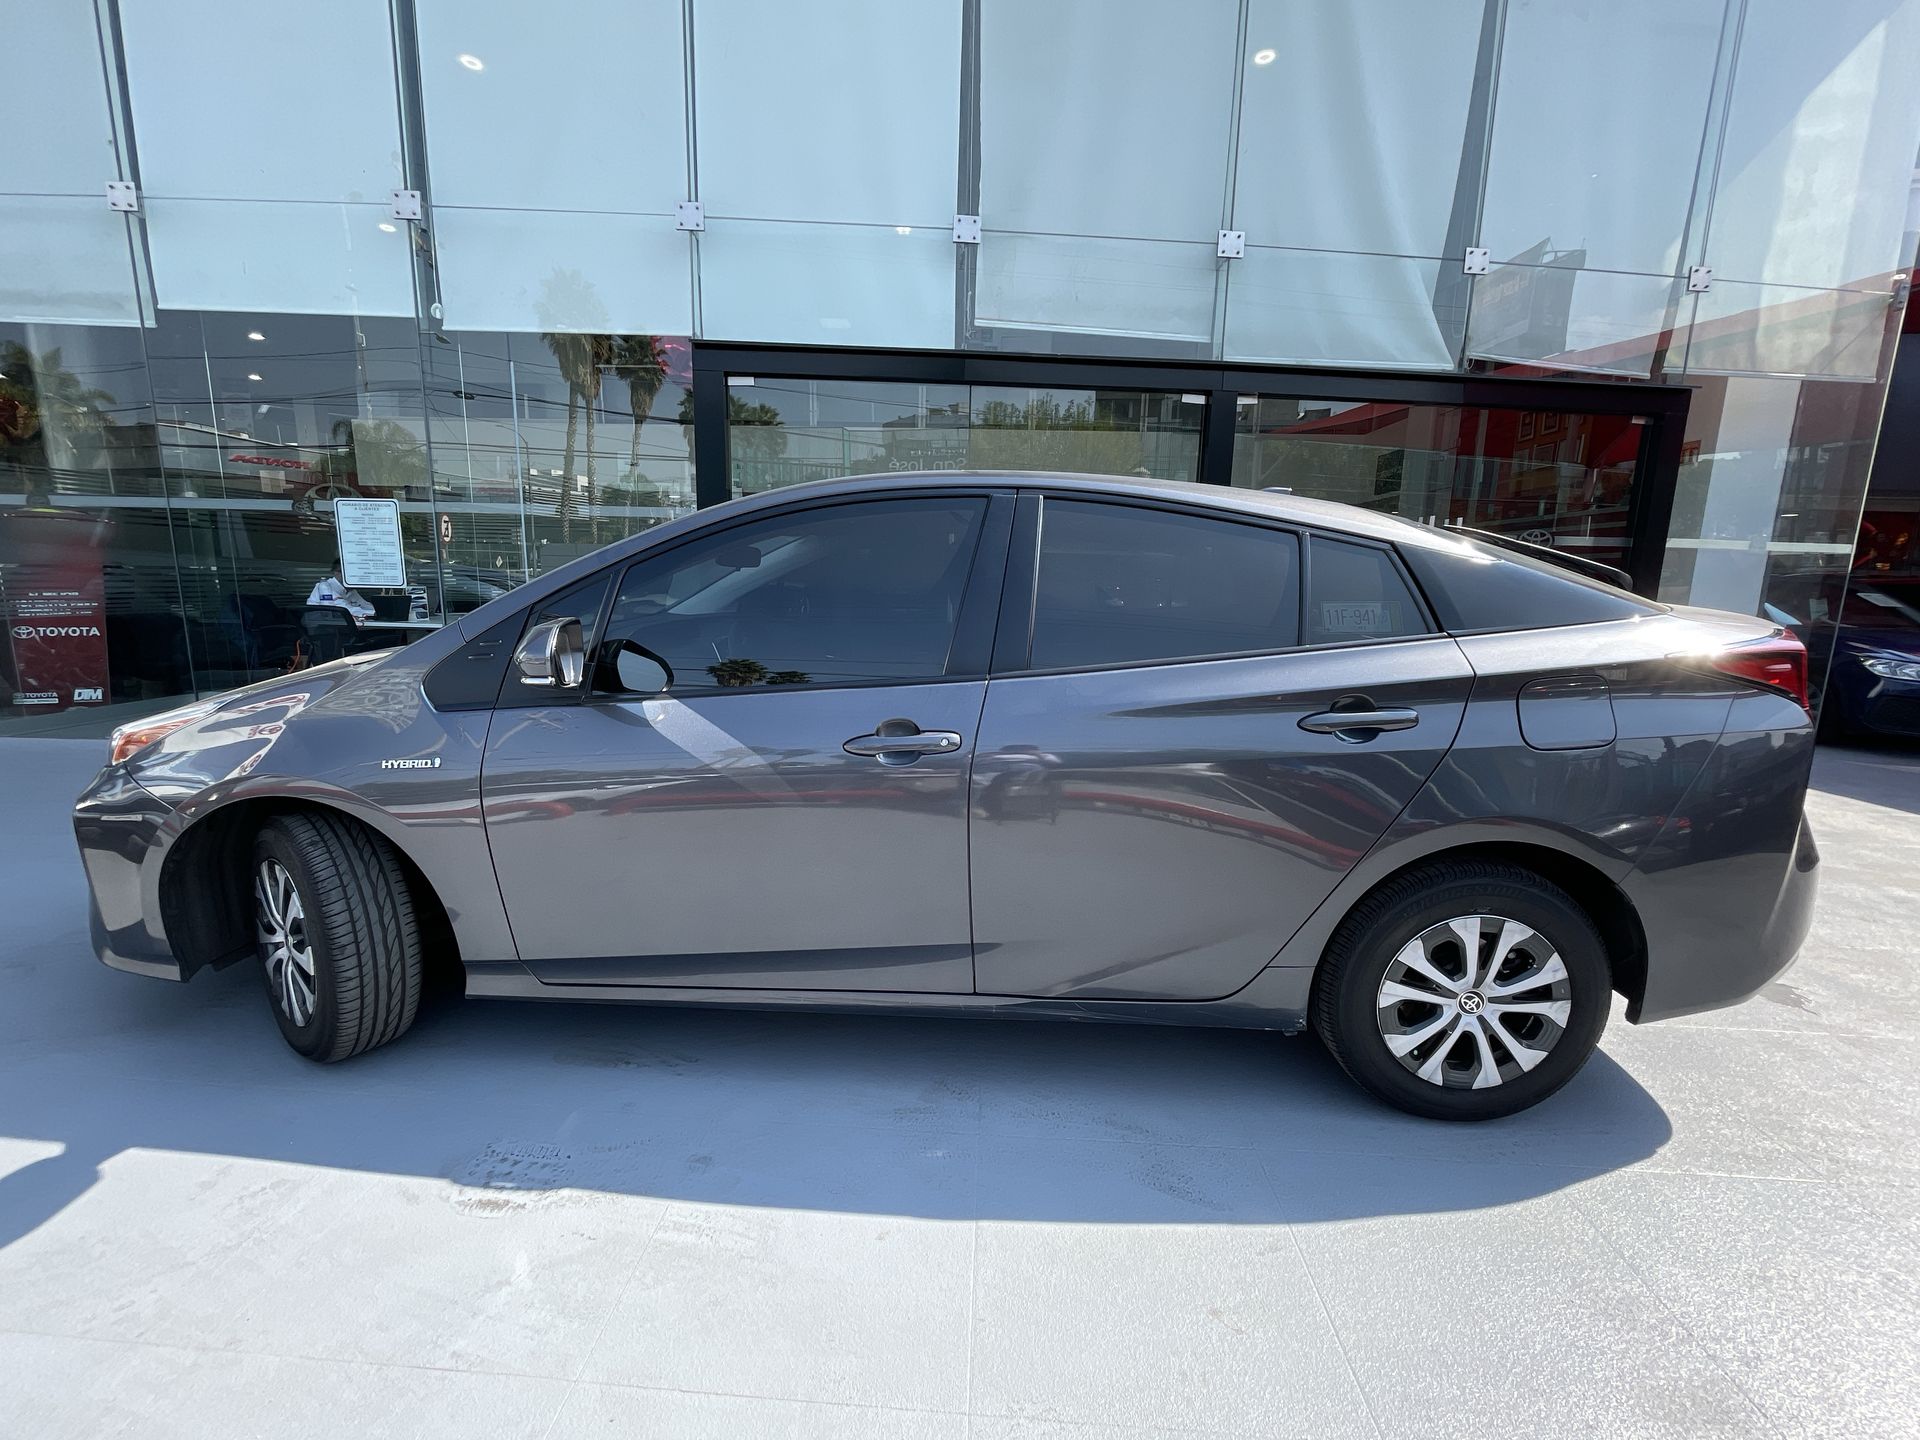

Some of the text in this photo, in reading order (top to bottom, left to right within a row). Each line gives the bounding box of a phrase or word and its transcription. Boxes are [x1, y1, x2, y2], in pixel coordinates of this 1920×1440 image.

[1326, 608, 1376, 625] 11F-941
[37, 627, 101, 637] TOYOTA
[381, 759, 433, 769] HYBRID
